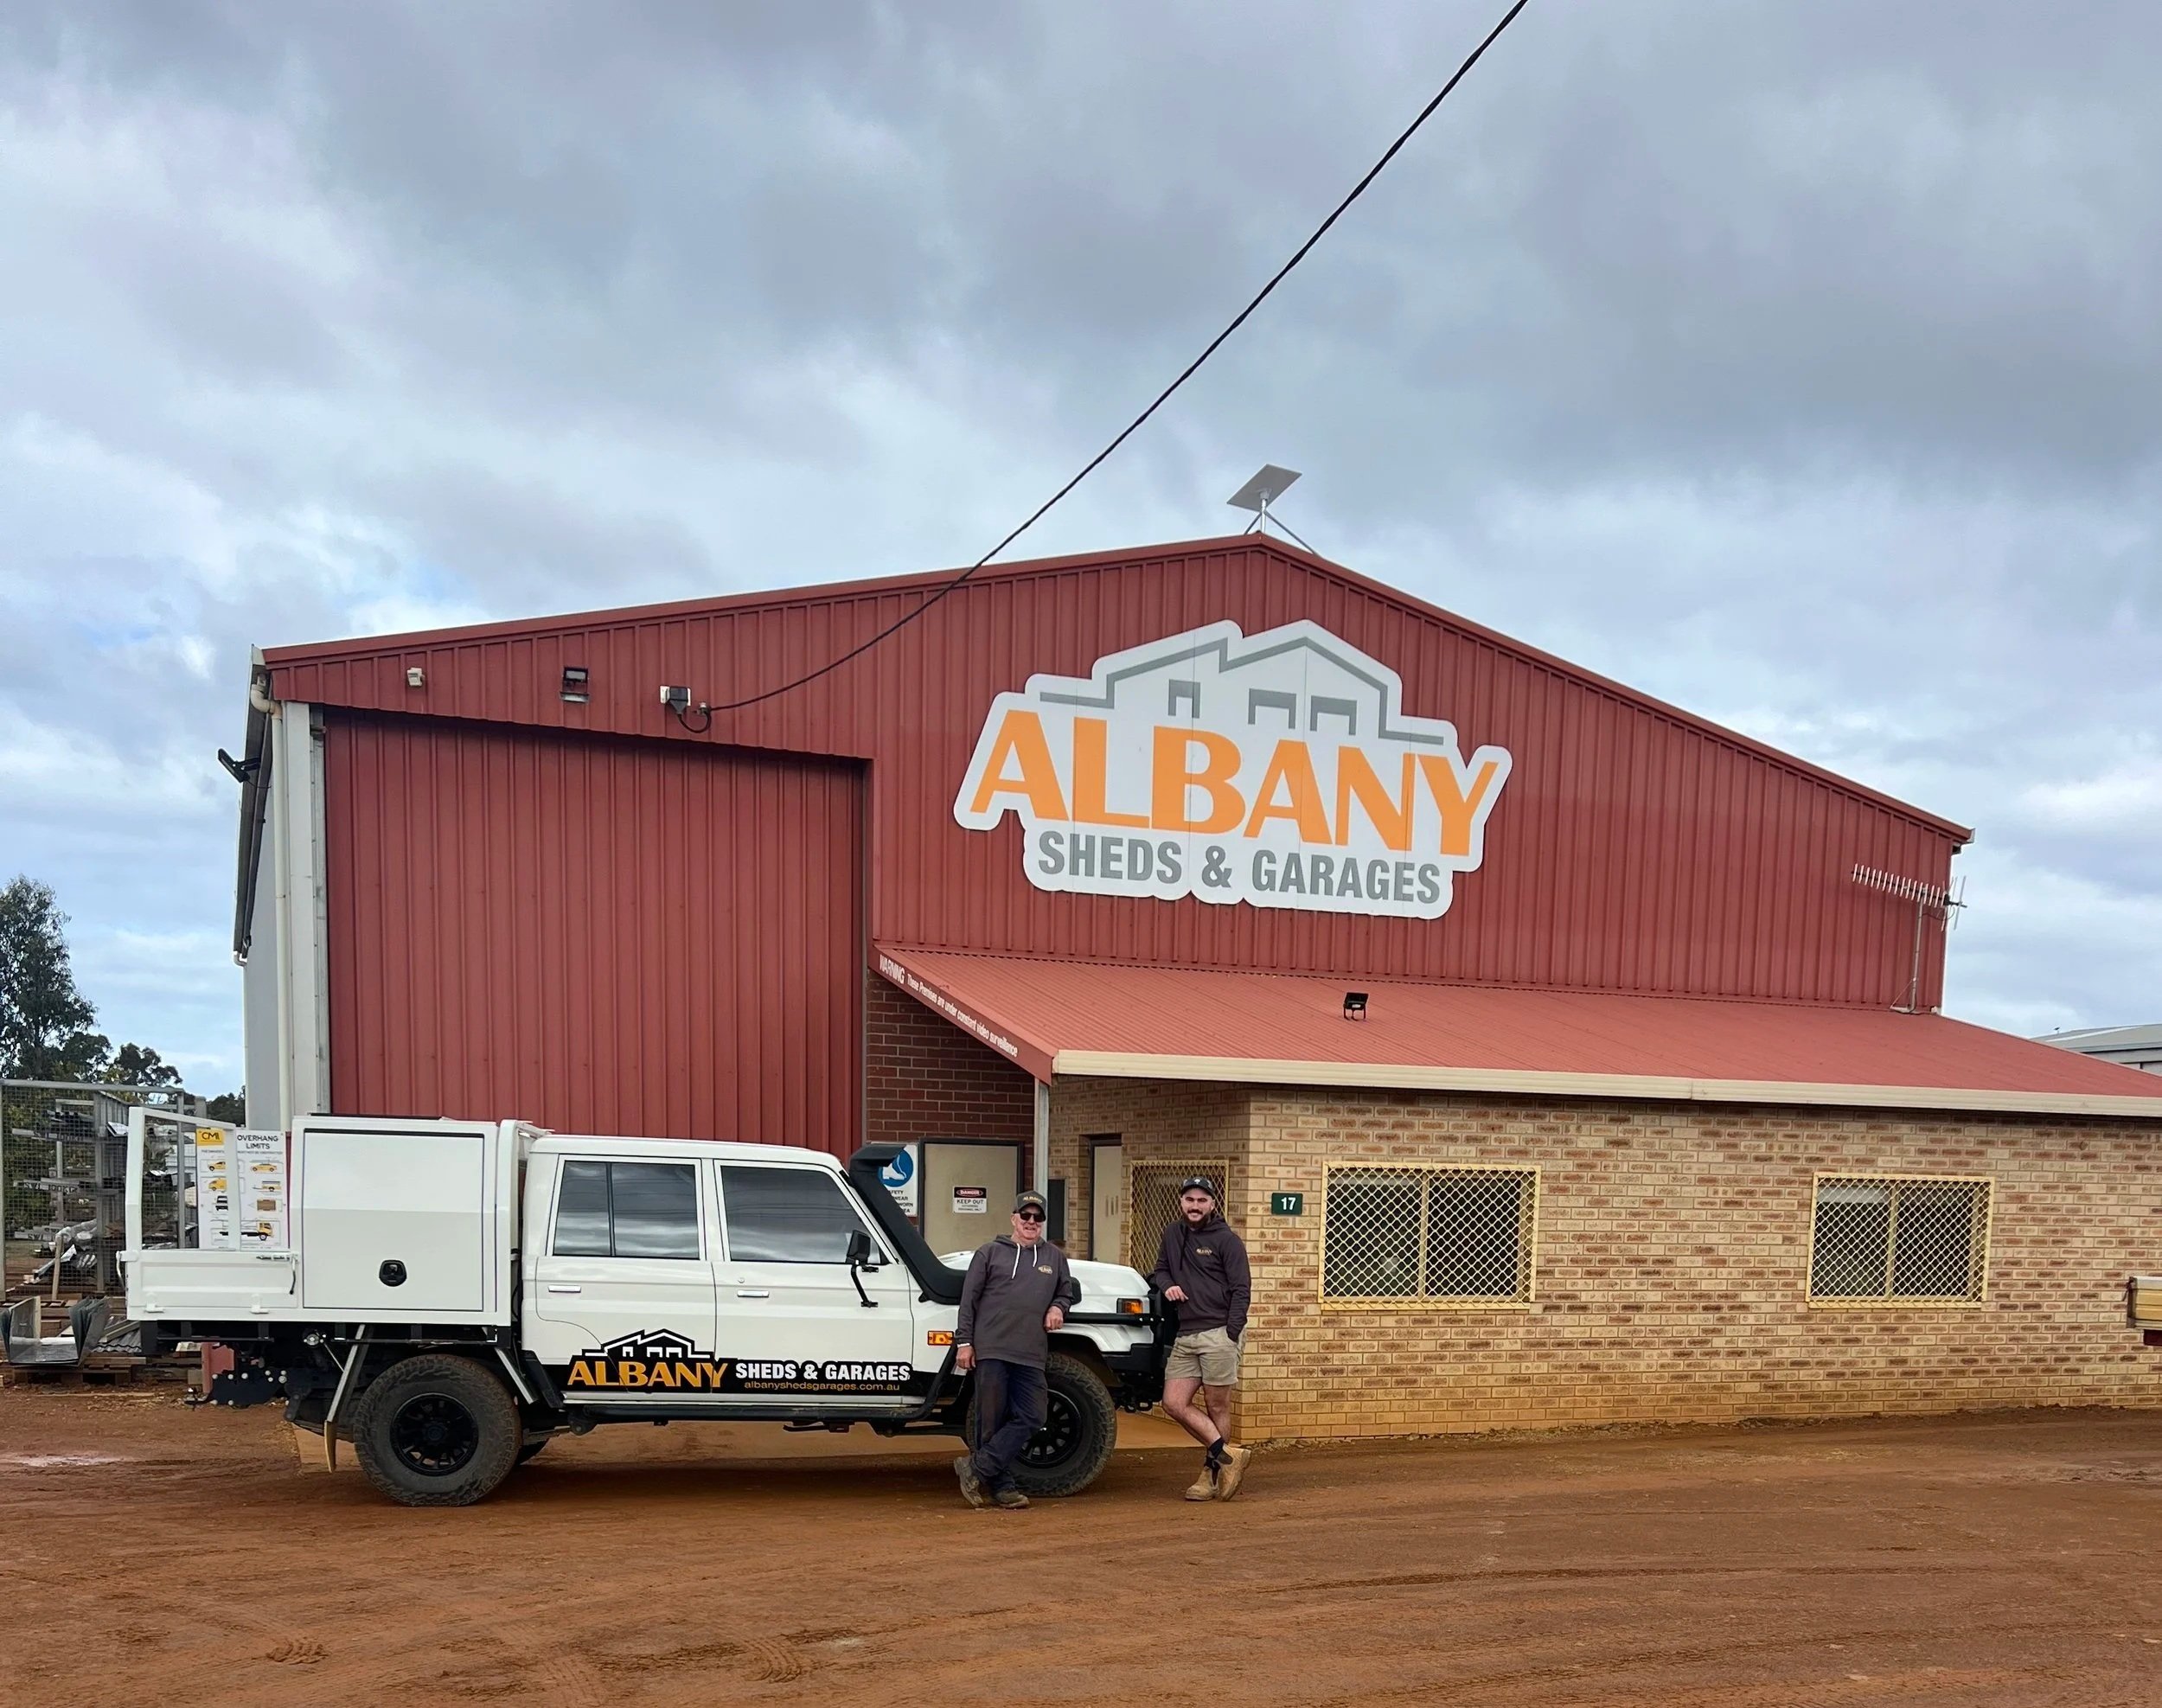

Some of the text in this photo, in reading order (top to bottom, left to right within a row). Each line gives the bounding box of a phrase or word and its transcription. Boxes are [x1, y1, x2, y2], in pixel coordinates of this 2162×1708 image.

[969, 708, 1499, 857] ALBANY
[1038, 830, 1441, 904] SHEDS & GARAGES
[880, 954, 905, 984] WARNING
[907, 973, 919, 991] These
[919, 982, 937, 1003] Premises
[944, 1001, 957, 1016] under
[957, 1010, 977, 1031] constant
[976, 1022, 989, 1040] video
[989, 1032, 1018, 1057] surveillance
[1281, 1197, 1296, 1210] 17
[567, 1360, 911, 1388] ALBANY SHEDS & GARAGES
[744, 1381, 900, 1391] albanyshedsgarages.com.au
